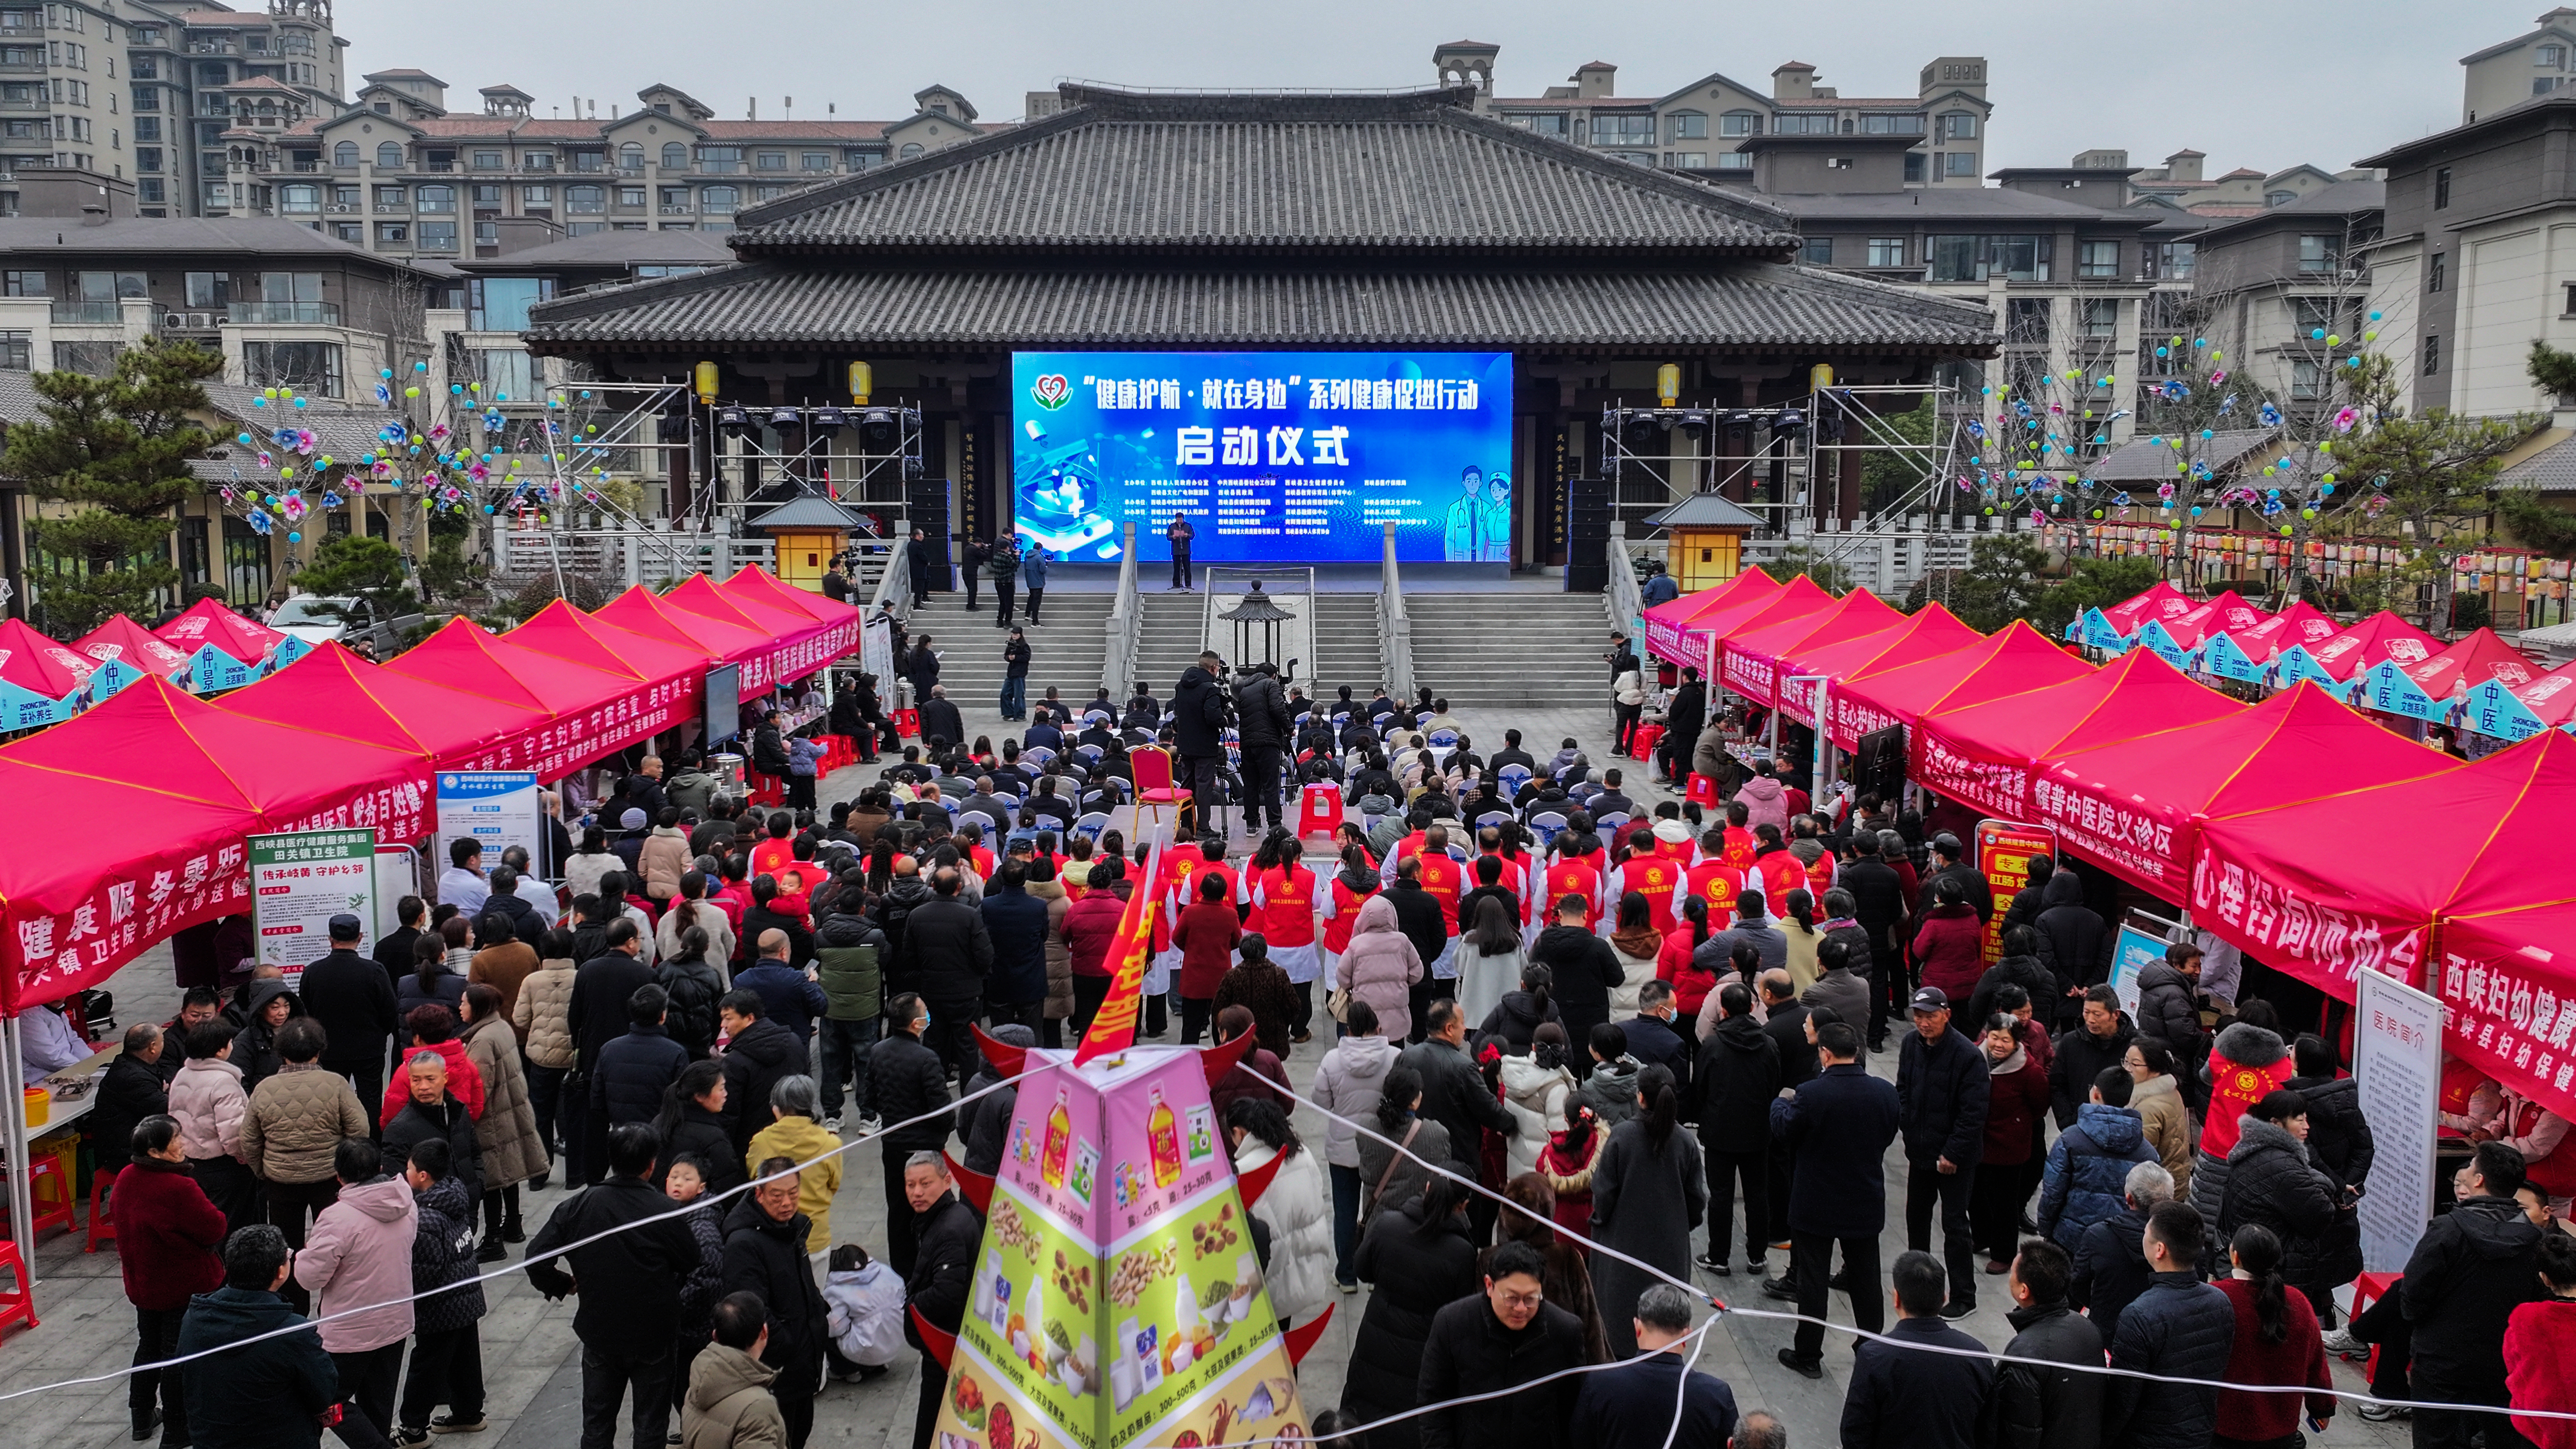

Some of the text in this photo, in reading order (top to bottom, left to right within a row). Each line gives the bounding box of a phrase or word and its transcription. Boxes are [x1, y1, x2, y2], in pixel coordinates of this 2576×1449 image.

[1308, 379, 1478, 410] 系列健康促进行动
[1176, 425, 1349, 466] 启动仪式
[2088, 610, 2097, 644] 仲景
[202, 648, 215, 690] 仲景
[739, 620, 859, 692] 峡县人民医院健康促进宣教义诊
[2214, 635, 2225, 673] 中医
[225, 673, 247, 685] 生活家居
[2379, 664, 2393, 708] 中医
[19, 709, 53, 725] 滋补养生
[20, 699, 51, 711] ZHONGJING
[2400, 701, 2427, 716] 文创系列
[2482, 683, 2498, 732] 中医
[2510, 726, 2539, 740] 文创系
[2512, 716, 2540, 729] ZHONGJING
[523, 719, 583, 761] 守正创新
[2034, 778, 2173, 861] 耀普中医院义诊区
[255, 833, 367, 850] 西峡县医疗健康服务集团
[274, 845, 349, 862] 田关镇卫生院
[316, 864, 364, 877] 守护乡邻
[1989, 874, 2014, 886] 肛肠
[2193, 848, 2419, 984] 心理咨询师协会
[2374, 1010, 2424, 1051] 医院简介
